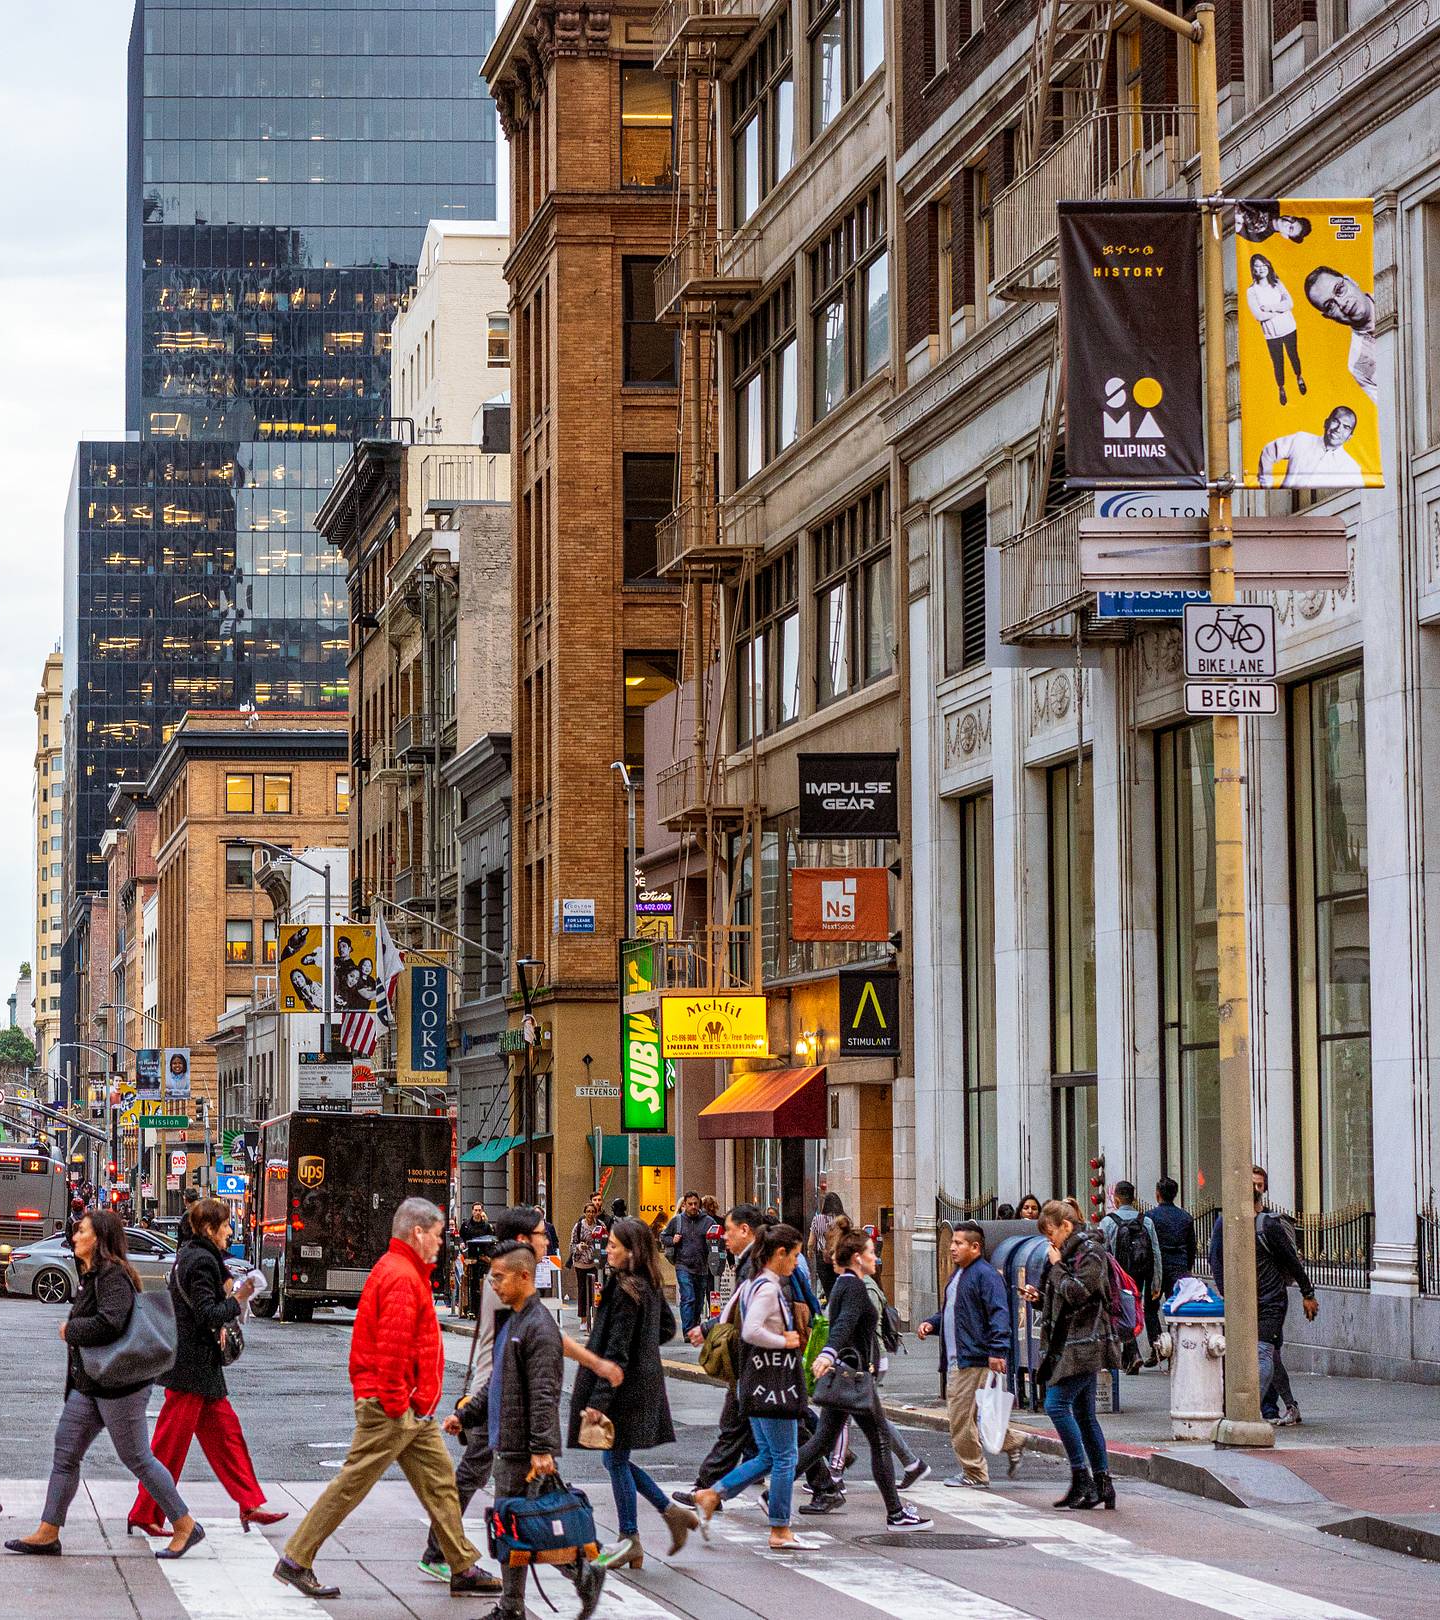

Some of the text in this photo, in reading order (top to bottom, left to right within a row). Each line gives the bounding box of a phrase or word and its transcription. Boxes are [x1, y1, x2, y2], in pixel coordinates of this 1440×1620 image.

[1093, 266, 1165, 277] HISTORY
[1104, 444, 1166, 458] PILIPINAS
[1198, 659, 1264, 673] BIKE LANE
[1202, 690, 1261, 708] BEGIN
[805, 782, 892, 797] IMPULSE
[822, 799, 876, 810] GEAR
[826, 901, 852, 918] Ns
[822, 923, 855, 931] NextSpace
[686, 1000, 742, 1019] Mehfil
[421, 970, 438, 1068] BOOKS
[847, 1037, 892, 1046] STIMULANT
[580, 1087, 621, 1096] STEVENSO
[30, 1161, 39, 1171] 12
[172, 1156, 186, 1166] CVS
[299, 1166, 324, 1184] ups
[640, 1204, 664, 1212] UCKS
[752, 1352, 797, 1370] BIEN
[752, 1384, 799, 1405] FAIT
